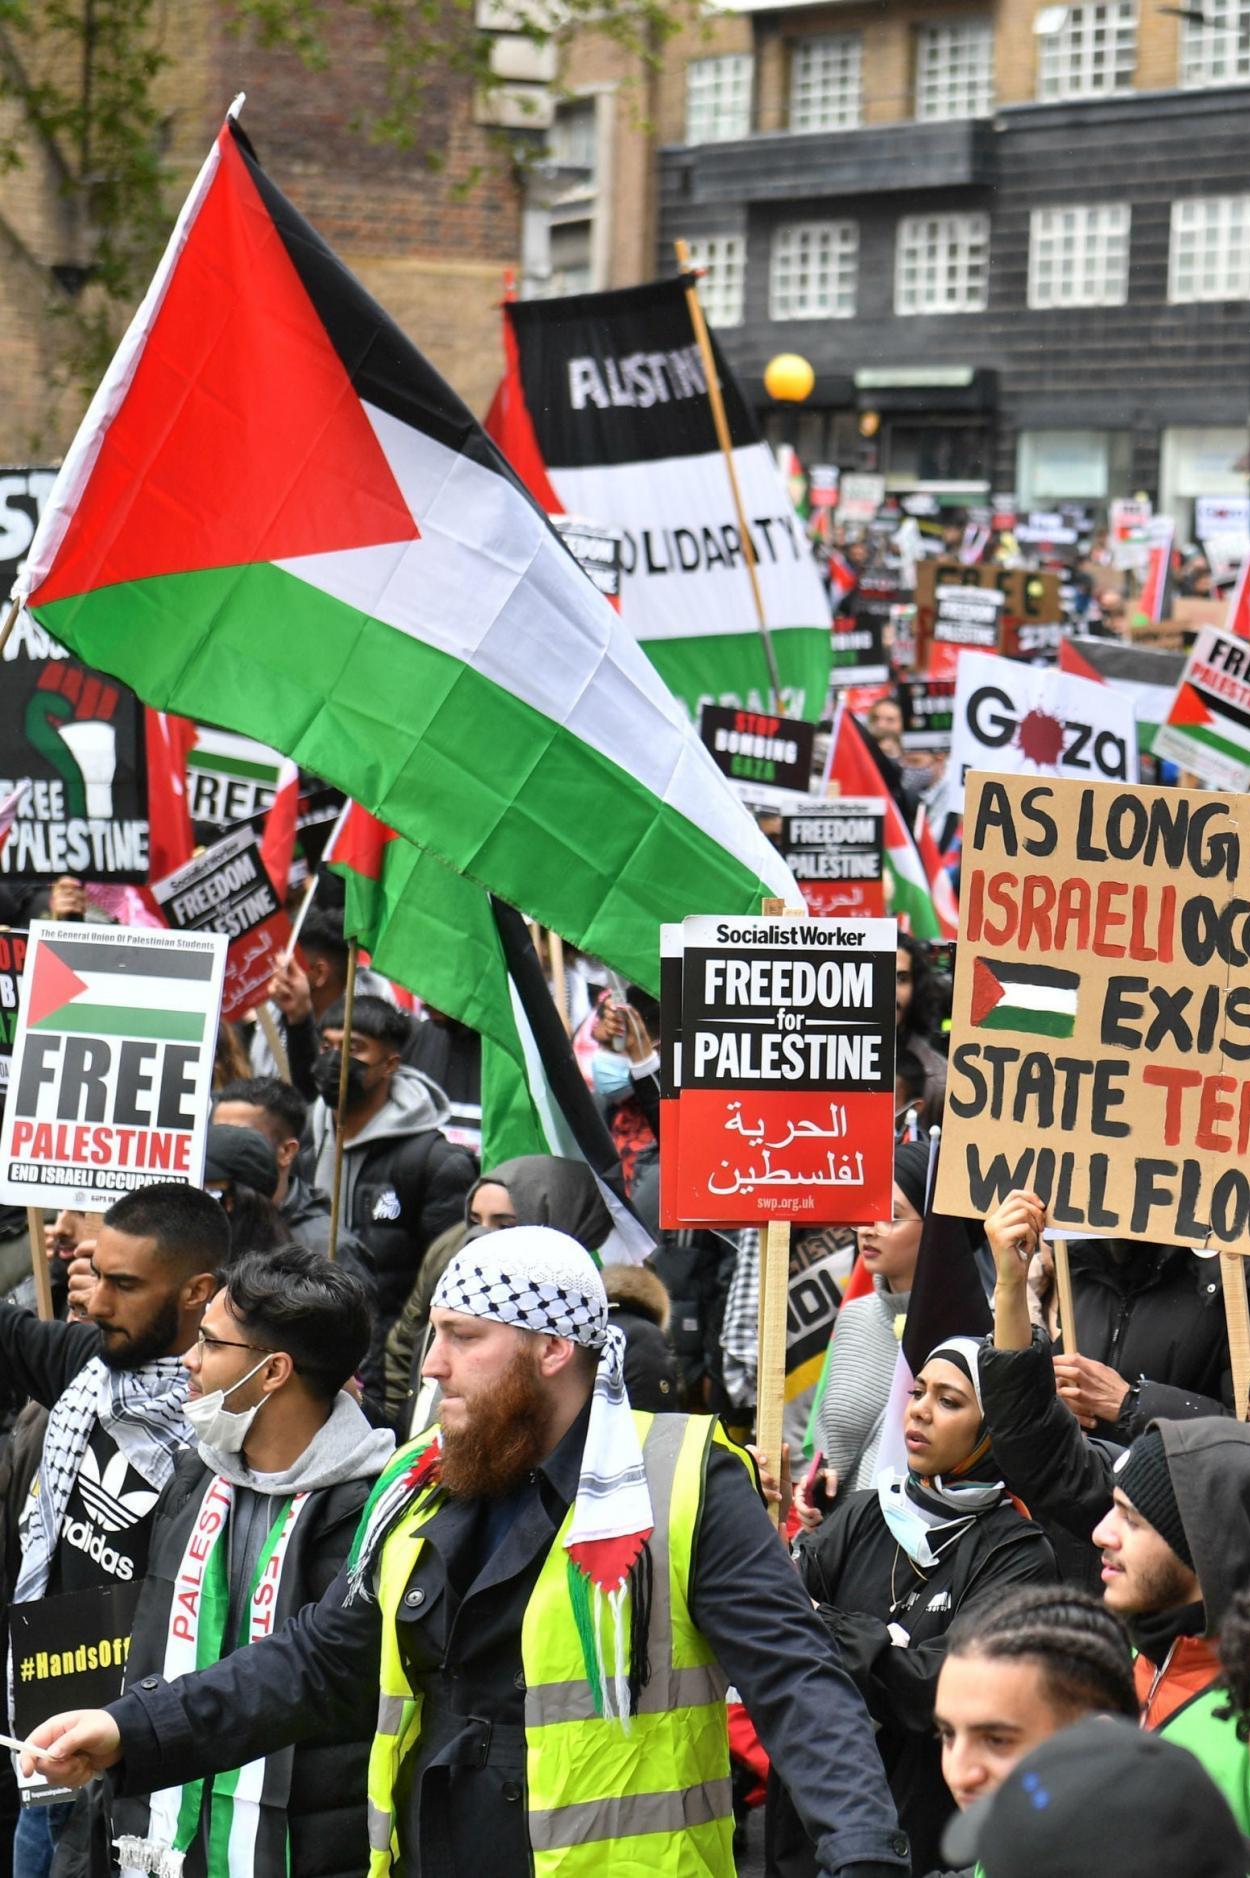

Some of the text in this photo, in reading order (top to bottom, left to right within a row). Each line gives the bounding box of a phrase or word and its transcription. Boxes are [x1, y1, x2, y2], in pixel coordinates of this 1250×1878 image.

[619, 516, 800, 575] OLIDARITY
[966, 686, 1127, 784] Gza
[186, 772, 276, 828] REE
[3, 818, 149, 873] PALESTINE
[790, 818, 876, 845] FREEDOM
[973, 781, 1058, 858] AS
[1075, 789, 1240, 883] LONG
[172, 852, 258, 927] FREEDOM
[784, 852, 880, 880] PALESTINE
[202, 885, 277, 938] ESTINE
[716, 923, 866, 946] Socialist Worker
[966, 869, 1177, 964] ISRAELI
[41, 928, 215, 950] The General Union Of Palestinian Students
[704, 959, 873, 1008] FREEDOM
[776, 1007, 805, 1031] for
[694, 1031, 882, 1081] PALESTINE
[15, 1033, 201, 1131] FREE
[949, 1042, 1132, 1138] STATE
[10, 1121, 193, 1171] PALESTINE
[724, 1101, 848, 1149] الحرية
[11, 1163, 187, 1191] END ISRAELI OCCUPA
[707, 1149, 865, 1196] لفلسطين
[965, 1143, 1120, 1230] WILL
[757, 1196, 815, 1212] swp.org.uk
[172, 1473, 235, 1644] PALEST
